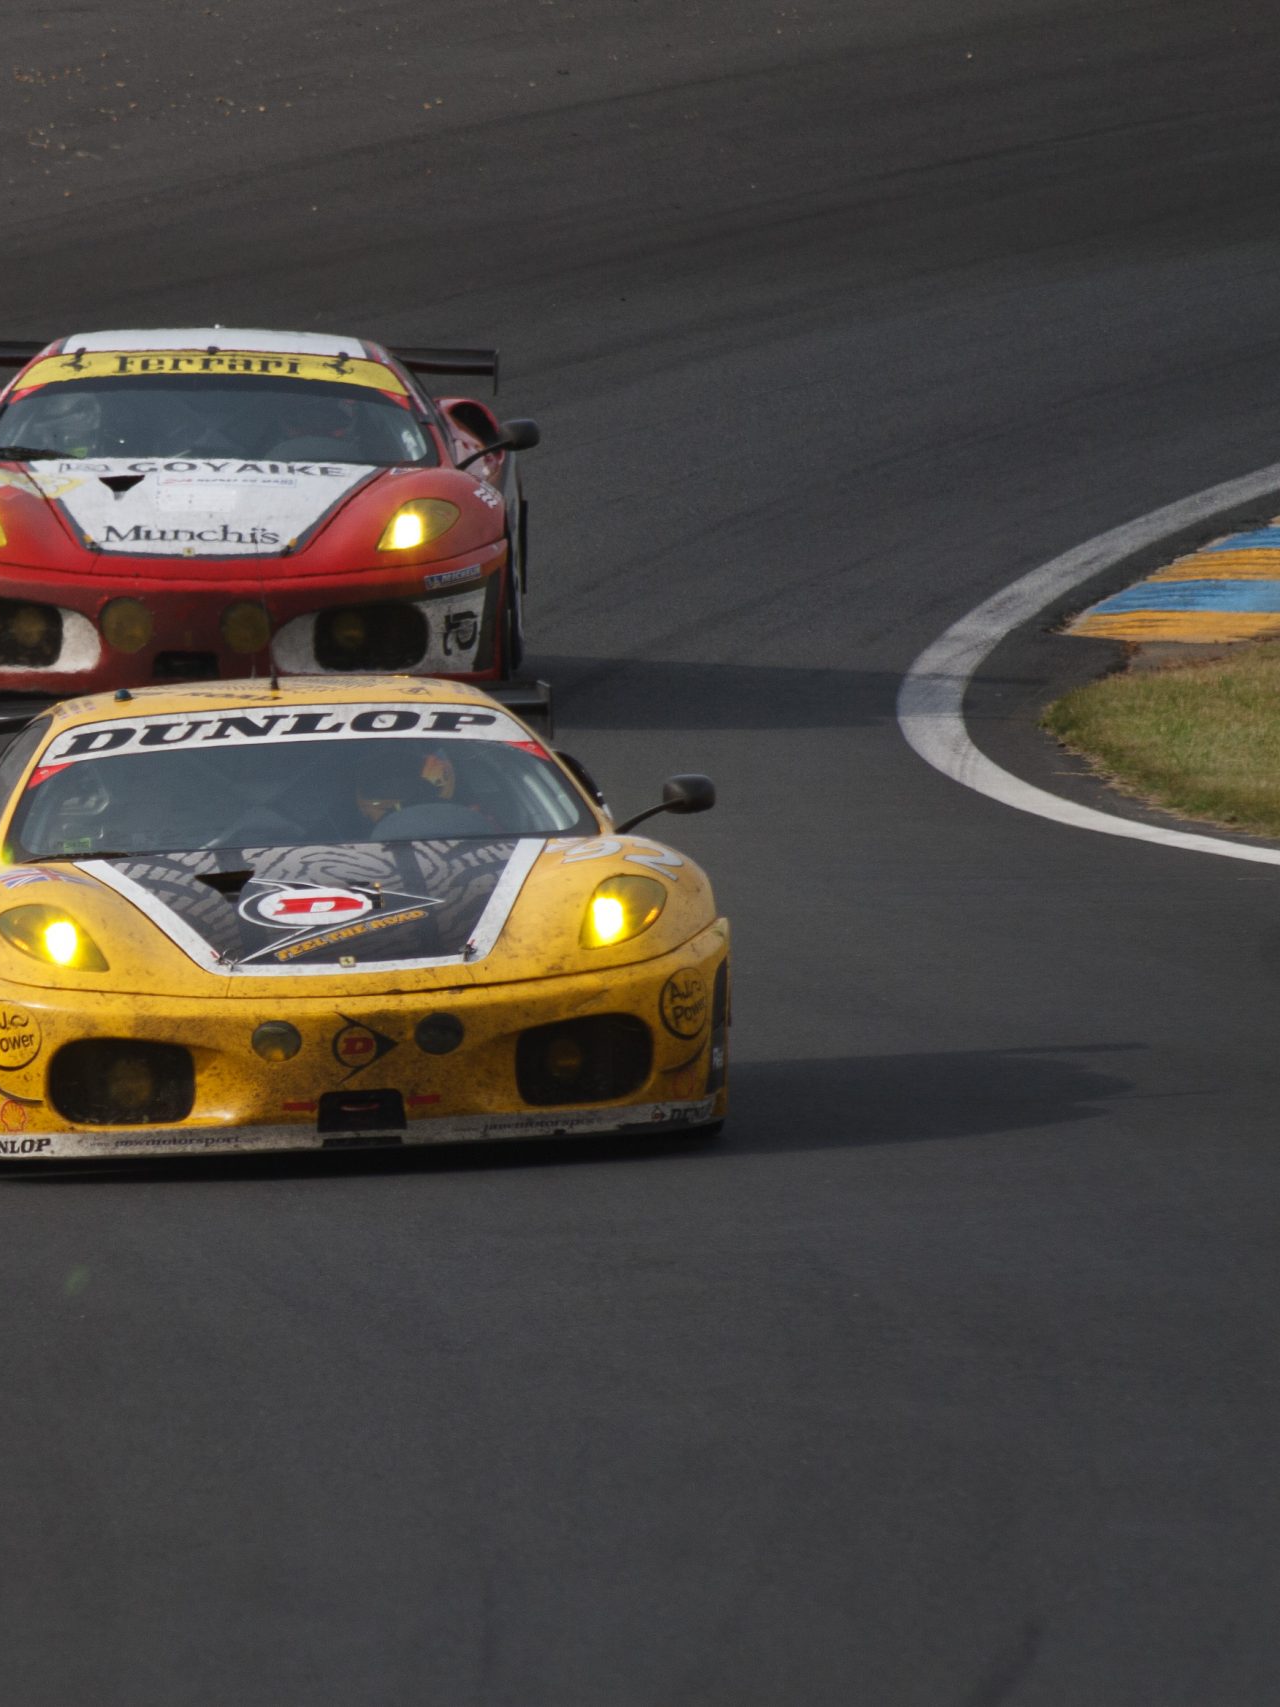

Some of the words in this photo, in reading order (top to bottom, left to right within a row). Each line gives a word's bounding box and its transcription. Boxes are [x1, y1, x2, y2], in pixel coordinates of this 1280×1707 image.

[118, 353, 301, 375] Ferrari
[127, 461, 348, 477] GOYAIKE
[54, 710, 497, 759] DUNLOP
[561, 840, 684, 881] 92
[274, 936, 329, 961] FEEL
[327, 922, 369, 943] THE
[370, 909, 428, 931] ROAD
